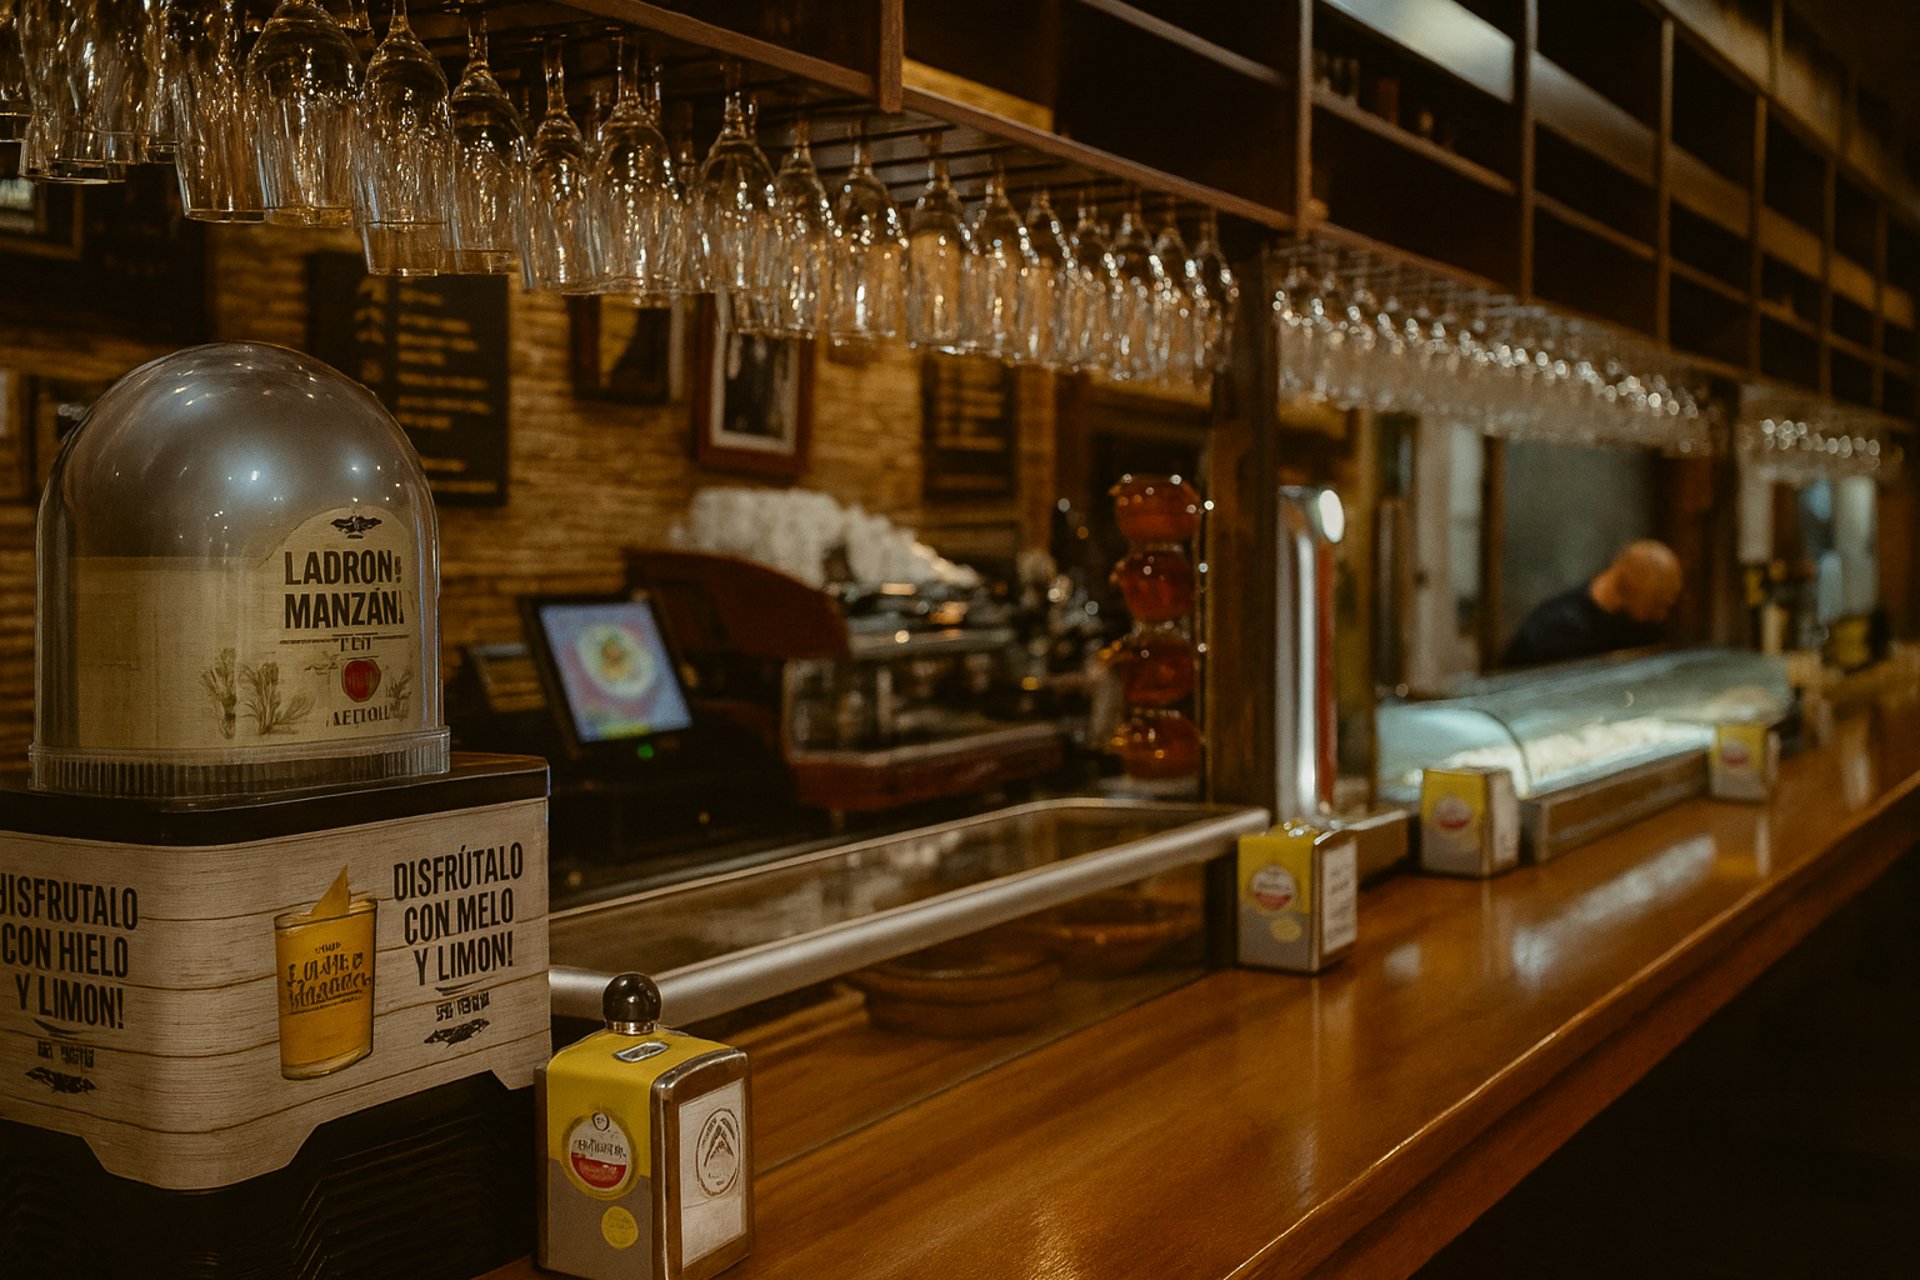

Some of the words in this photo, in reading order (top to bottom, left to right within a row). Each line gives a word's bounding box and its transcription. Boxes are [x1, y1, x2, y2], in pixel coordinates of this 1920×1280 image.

[393, 841, 523, 901] DISFRÚTALO
[404, 900, 451, 945] CON
[457, 887, 514, 934] MELO
[2, 922, 51, 970] CON
[58, 930, 128, 978] HIELO
[413, 948, 429, 986] Y
[438, 931, 513, 982] LIMON!
[15, 972, 31, 1011] Y
[38, 975, 124, 1030] LIMON!
